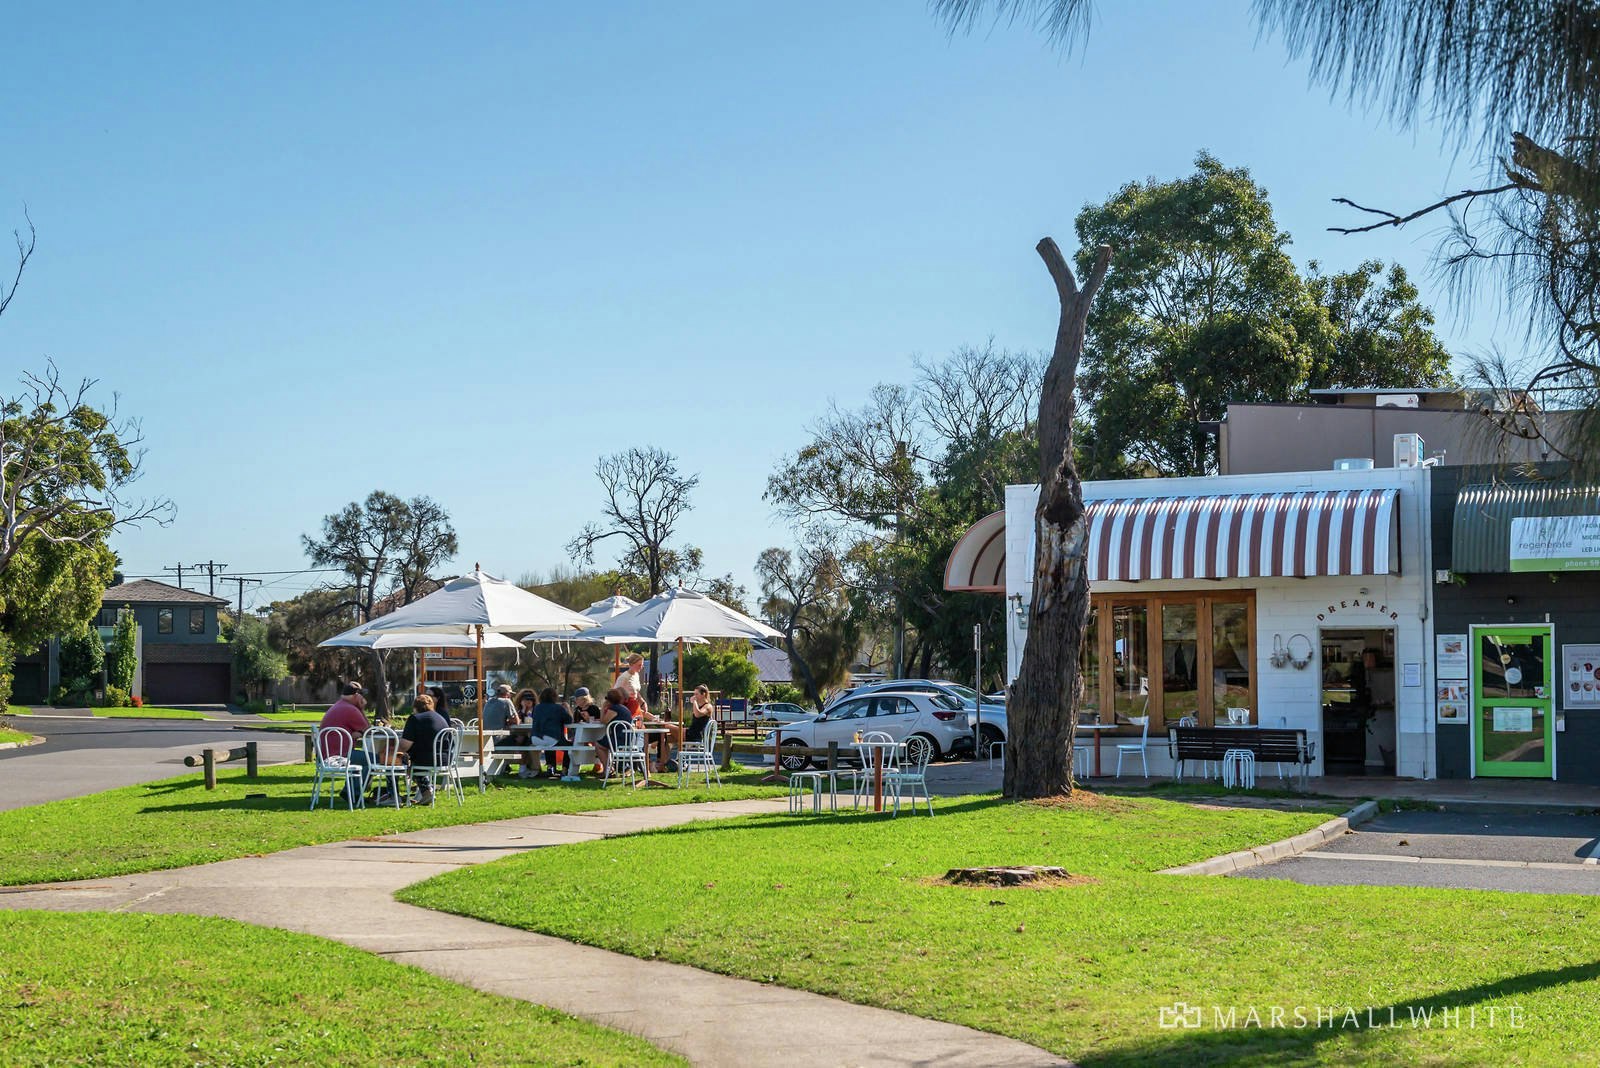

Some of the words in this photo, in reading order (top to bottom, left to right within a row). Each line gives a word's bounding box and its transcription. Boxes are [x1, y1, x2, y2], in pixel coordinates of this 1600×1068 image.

[1518, 541, 1573, 550] regenerate
[1565, 560, 1589, 568] phone
[1316, 600, 1398, 621] DREAMER
